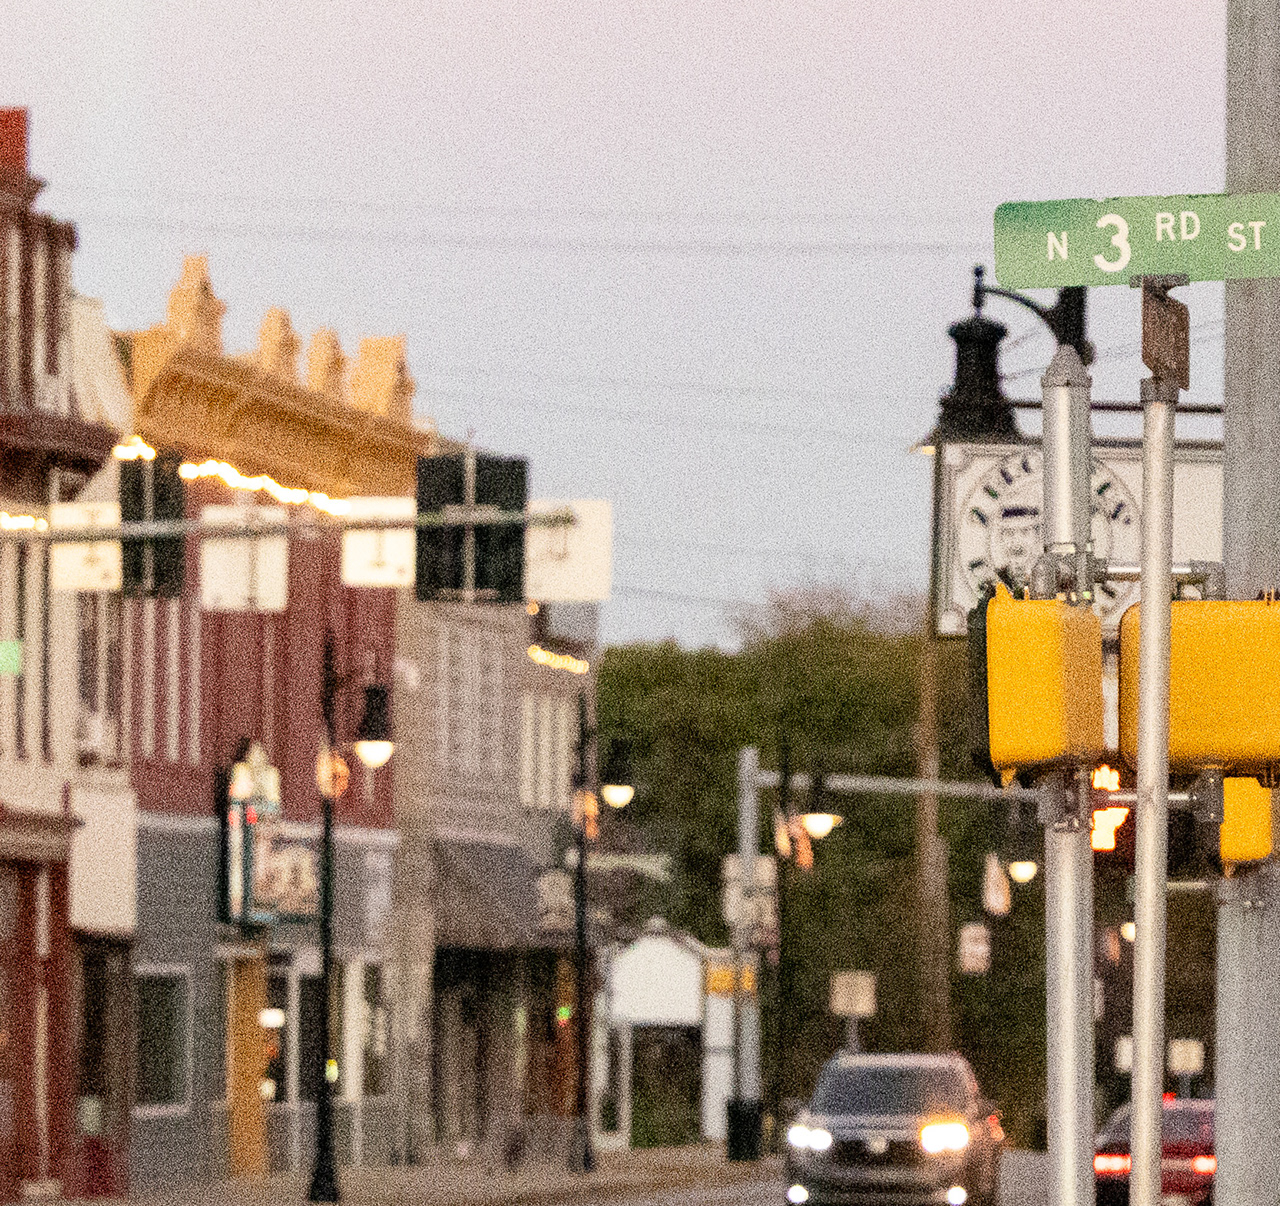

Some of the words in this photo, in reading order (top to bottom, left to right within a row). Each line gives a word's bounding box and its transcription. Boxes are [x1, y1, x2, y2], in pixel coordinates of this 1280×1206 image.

[1046, 231, 1069, 261] N
[1093, 213, 1132, 273] 3
[1155, 210, 1201, 242] RD
[1226, 221, 1267, 252] ST
